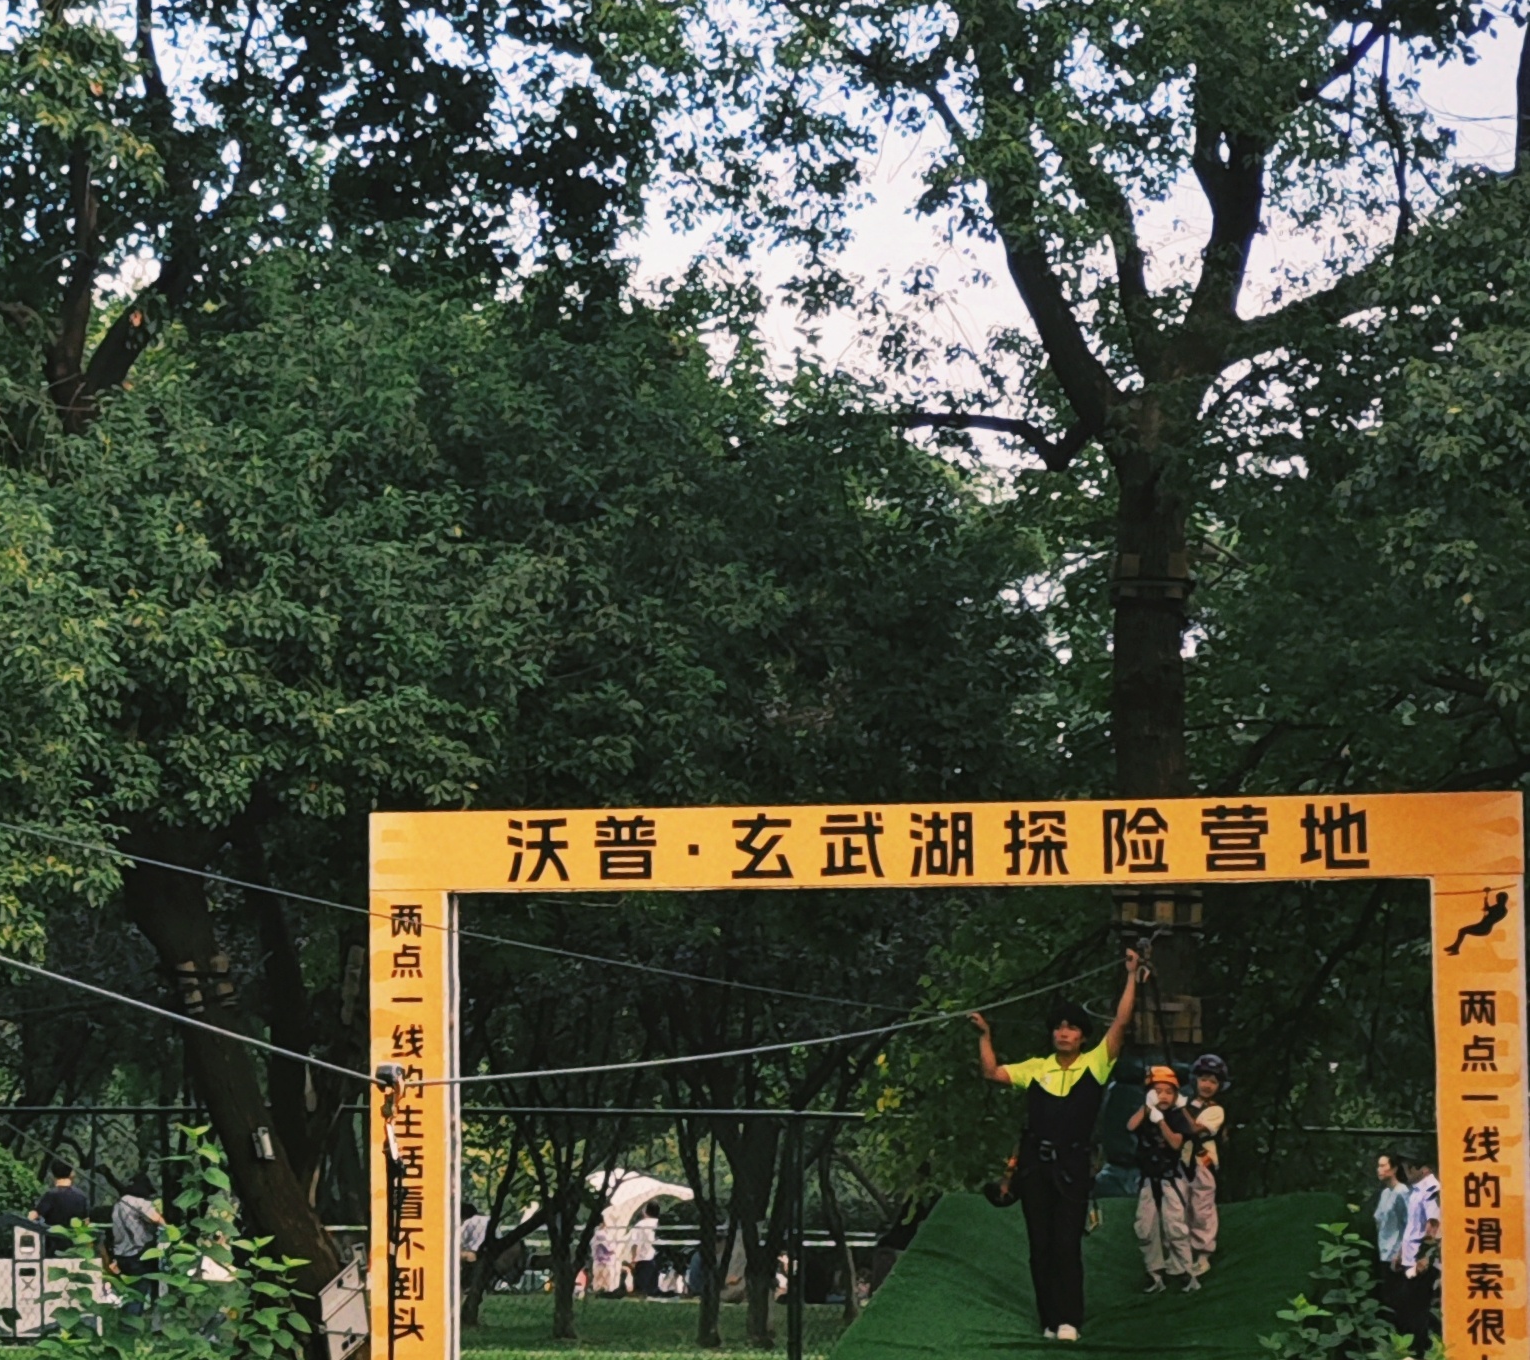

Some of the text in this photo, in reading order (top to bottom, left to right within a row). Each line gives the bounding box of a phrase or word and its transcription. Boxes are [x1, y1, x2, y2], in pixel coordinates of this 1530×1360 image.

[507, 803, 1370, 883] 沃普·玄武湖探险营地
